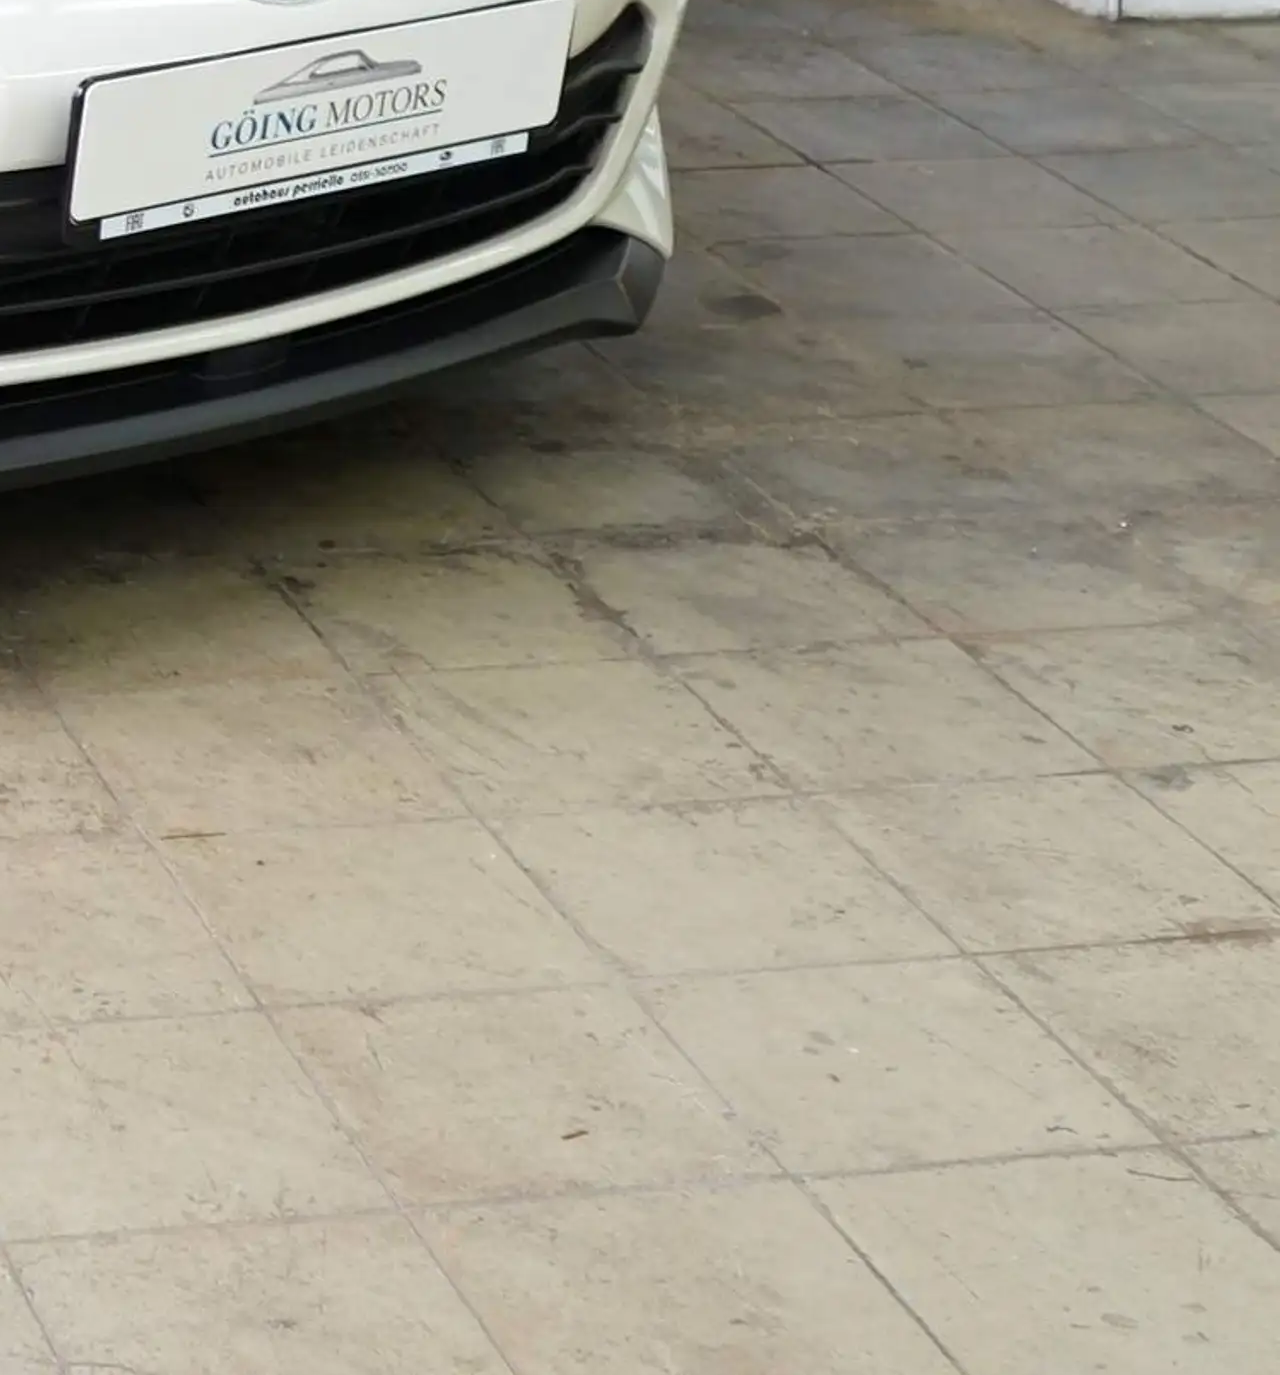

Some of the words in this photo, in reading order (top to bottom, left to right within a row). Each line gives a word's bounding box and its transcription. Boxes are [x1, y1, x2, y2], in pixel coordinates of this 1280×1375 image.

[210, 104, 318, 151] GÖING
[325, 78, 447, 128] MOTORS
[205, 148, 313, 182] AUTOMOBILE
[320, 122, 440, 158] LEIDENSCHAFT
